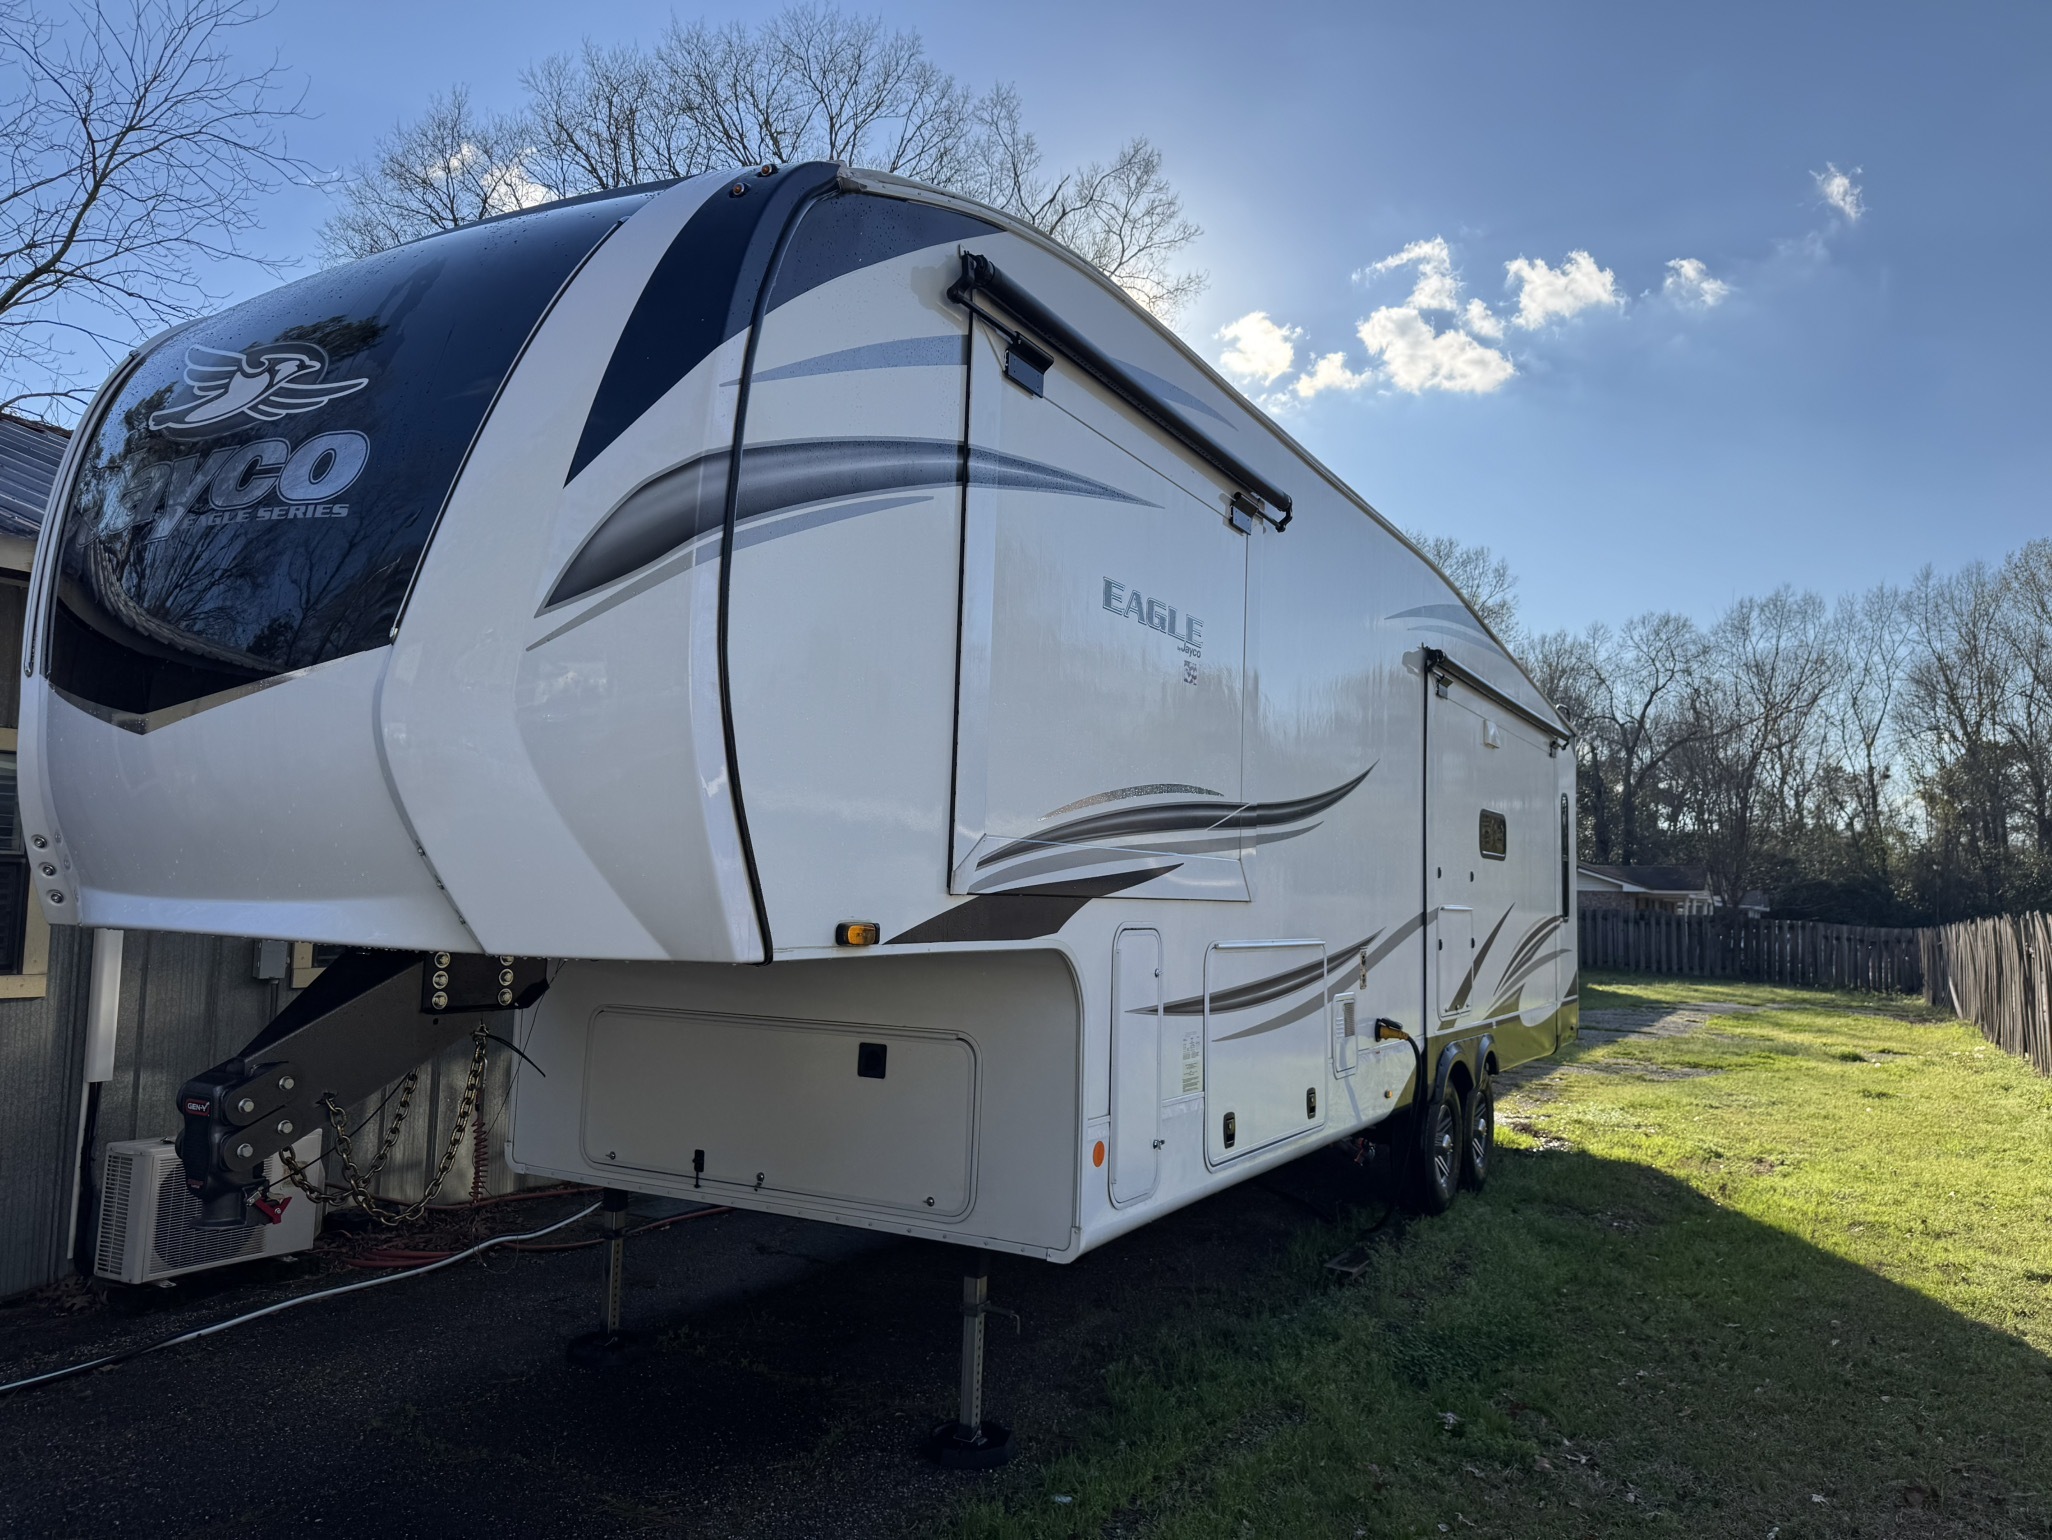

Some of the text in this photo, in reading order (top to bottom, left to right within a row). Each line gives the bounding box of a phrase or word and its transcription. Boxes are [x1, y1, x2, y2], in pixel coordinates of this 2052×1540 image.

[183, 503, 350, 529] EAGLE SERIES
[1102, 575, 1205, 649] EAGLE
[1180, 641, 1202, 659] Jayco
[187, 1101, 210, 1112] GEN-Y
